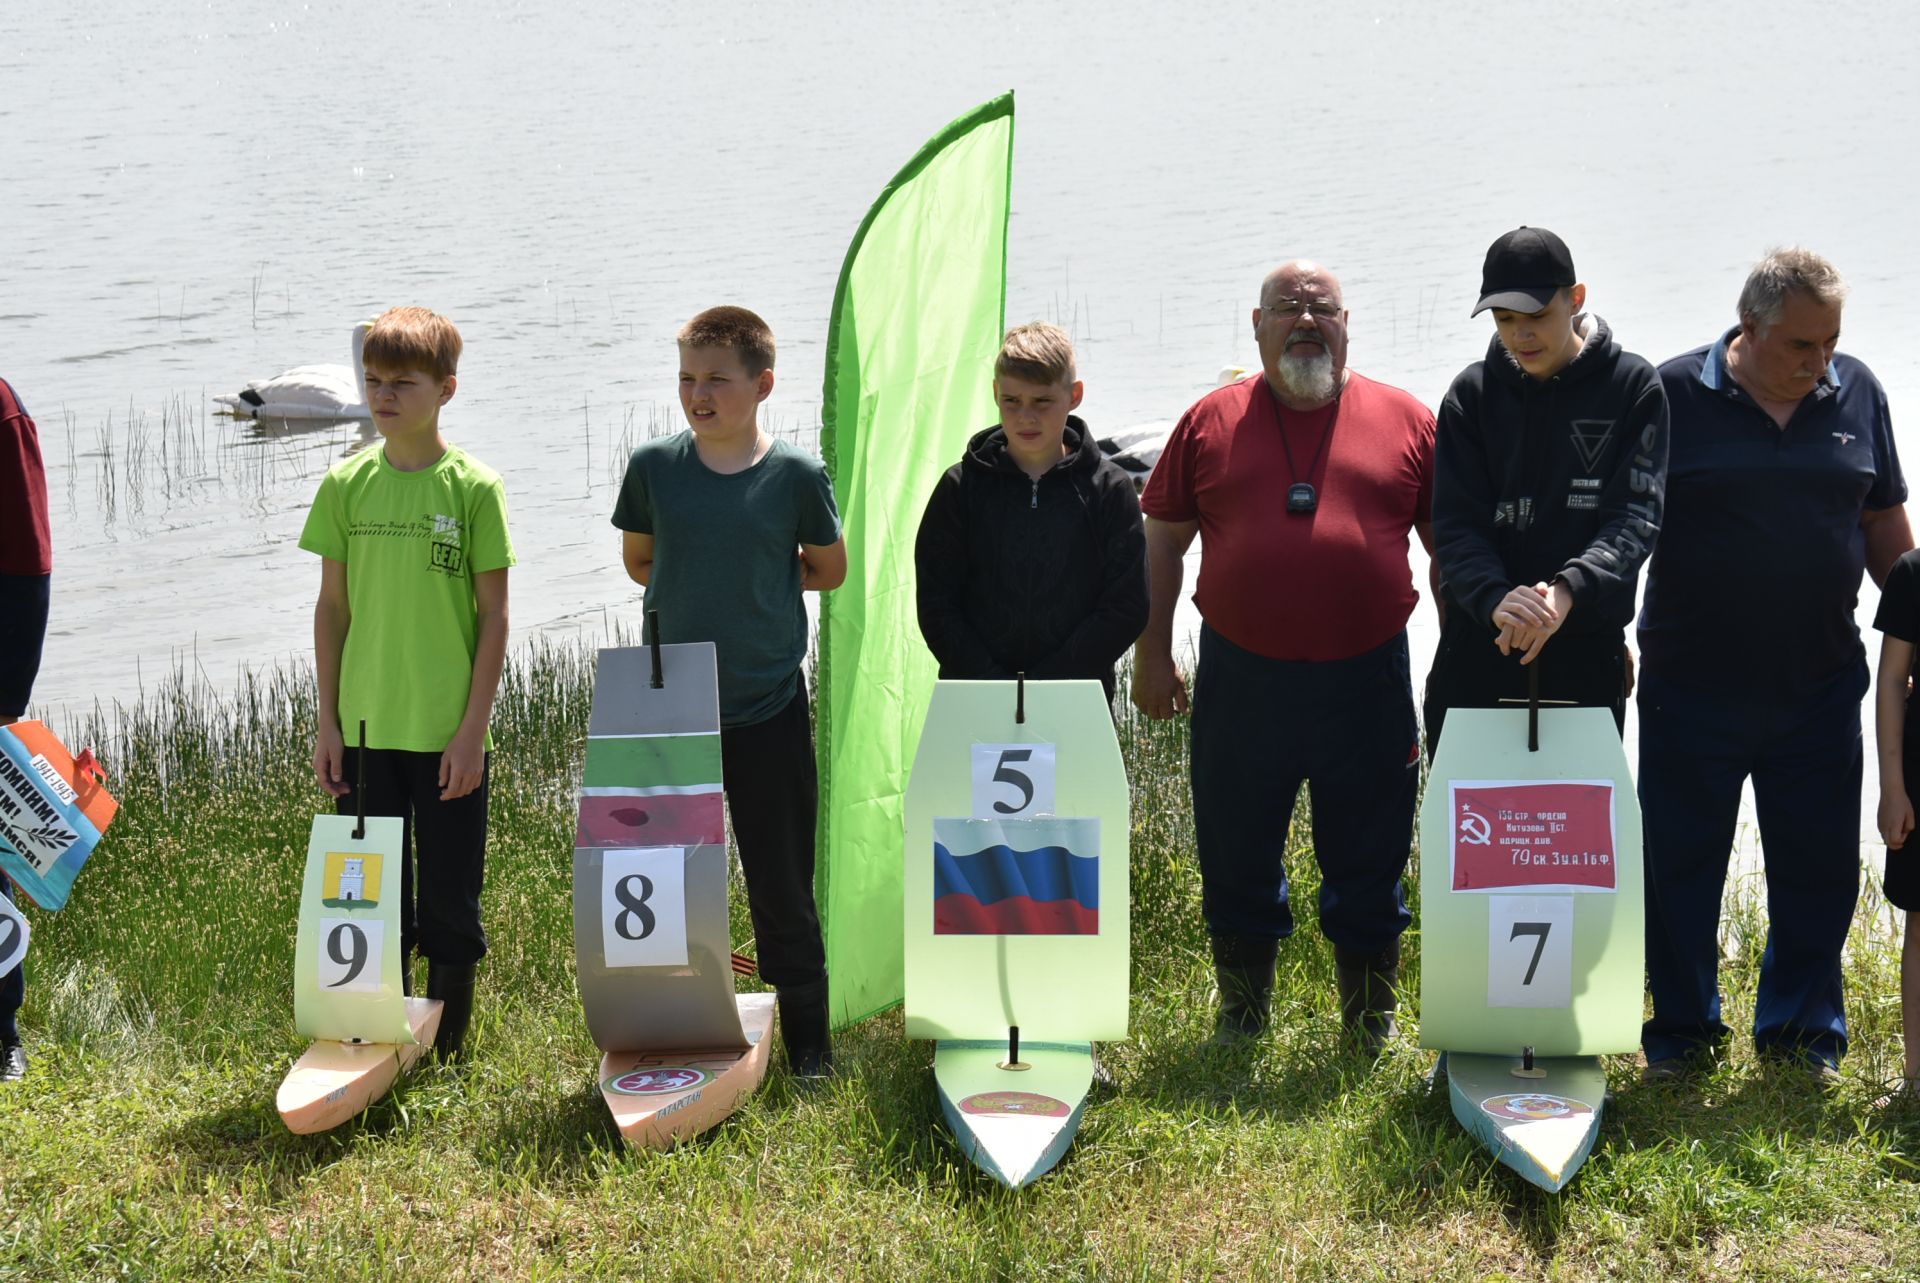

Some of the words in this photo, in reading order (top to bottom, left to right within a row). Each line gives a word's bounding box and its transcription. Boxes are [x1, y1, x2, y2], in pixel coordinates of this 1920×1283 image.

[0, 750, 60, 828] ОМНИМ!
[33, 759, 74, 800] 1941-1945
[993, 750, 1033, 814] 5
[1499, 810, 1512, 820] 150
[1511, 848, 1530, 865] 79
[615, 875, 655, 940] 8
[327, 923, 368, 988] 9
[1509, 922, 1552, 986] 7
[656, 1090, 702, 1120] ТАТАРСТАН
